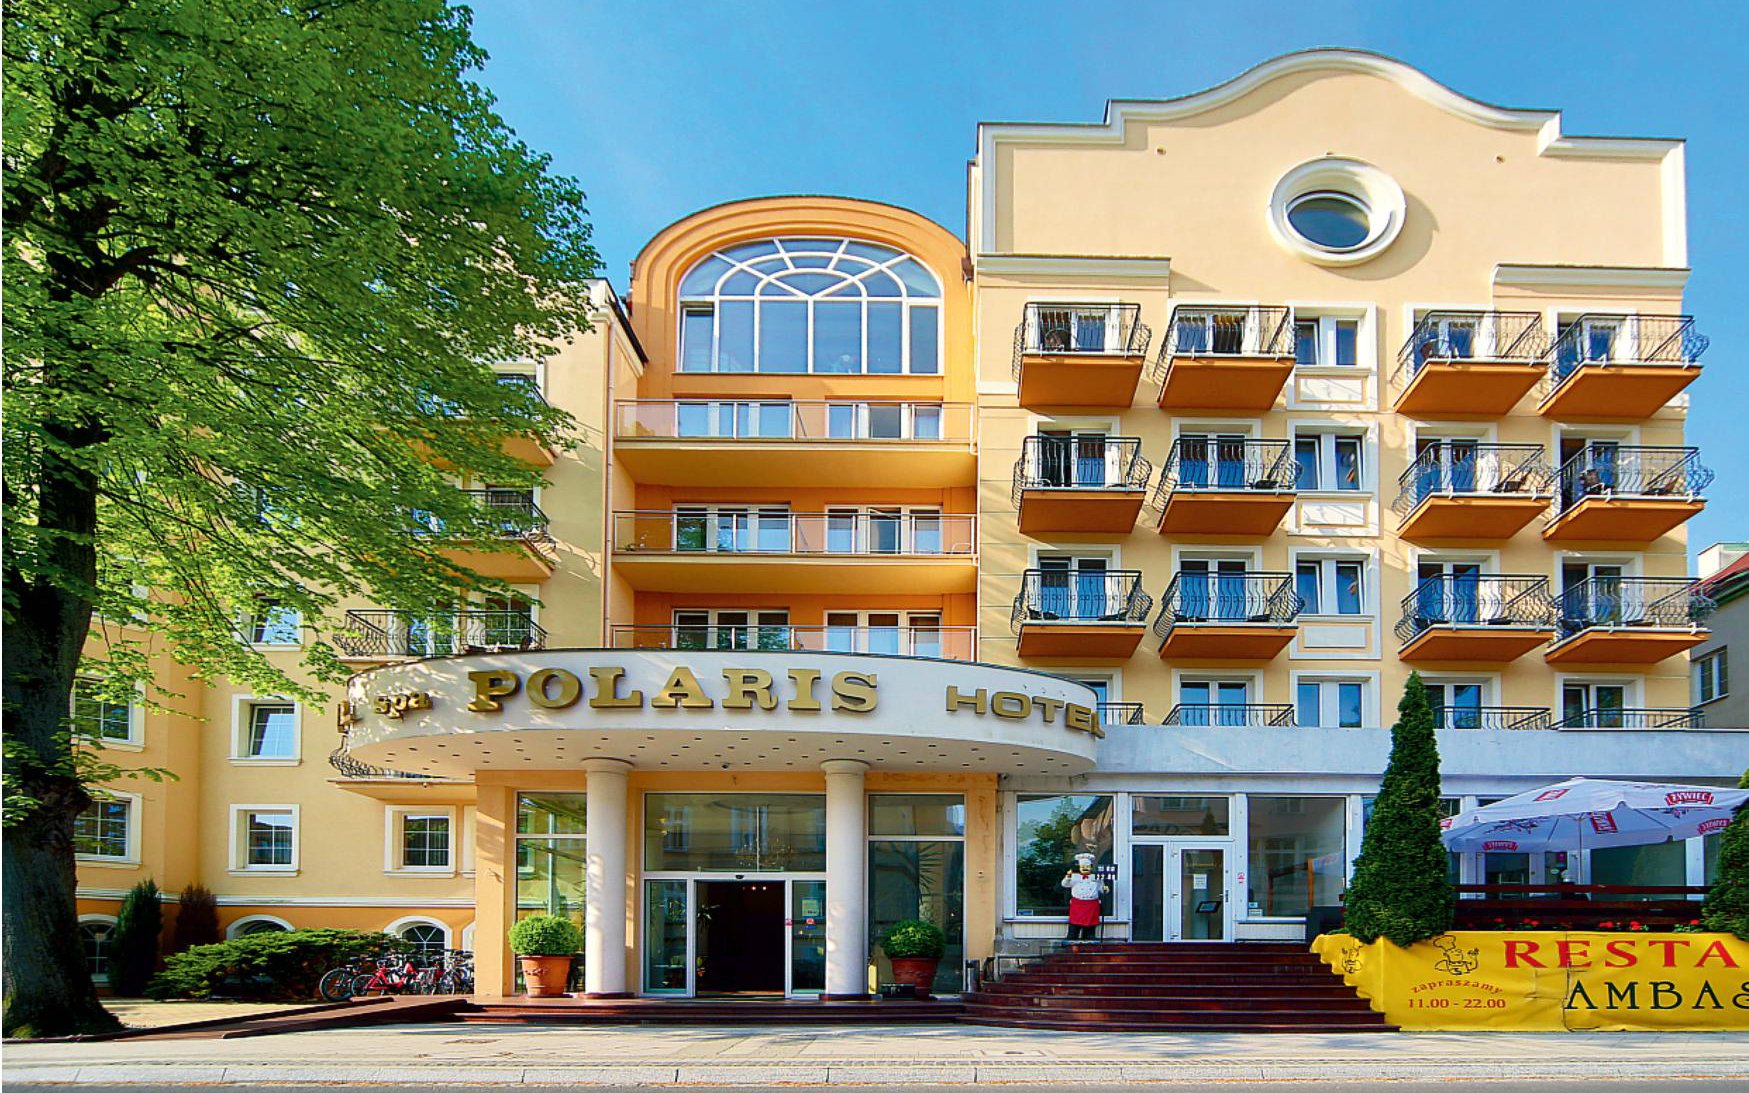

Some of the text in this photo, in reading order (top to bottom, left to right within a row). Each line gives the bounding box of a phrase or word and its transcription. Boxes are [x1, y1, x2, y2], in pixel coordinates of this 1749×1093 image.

[467, 666, 879, 713] POLARIS
[1503, 941, 1740, 968] RESTA
[1410, 980, 1503, 994] zapraszamy
[1408, 998, 1450, 1009] 11.00
[1463, 998, 1506, 1009] 22.00
